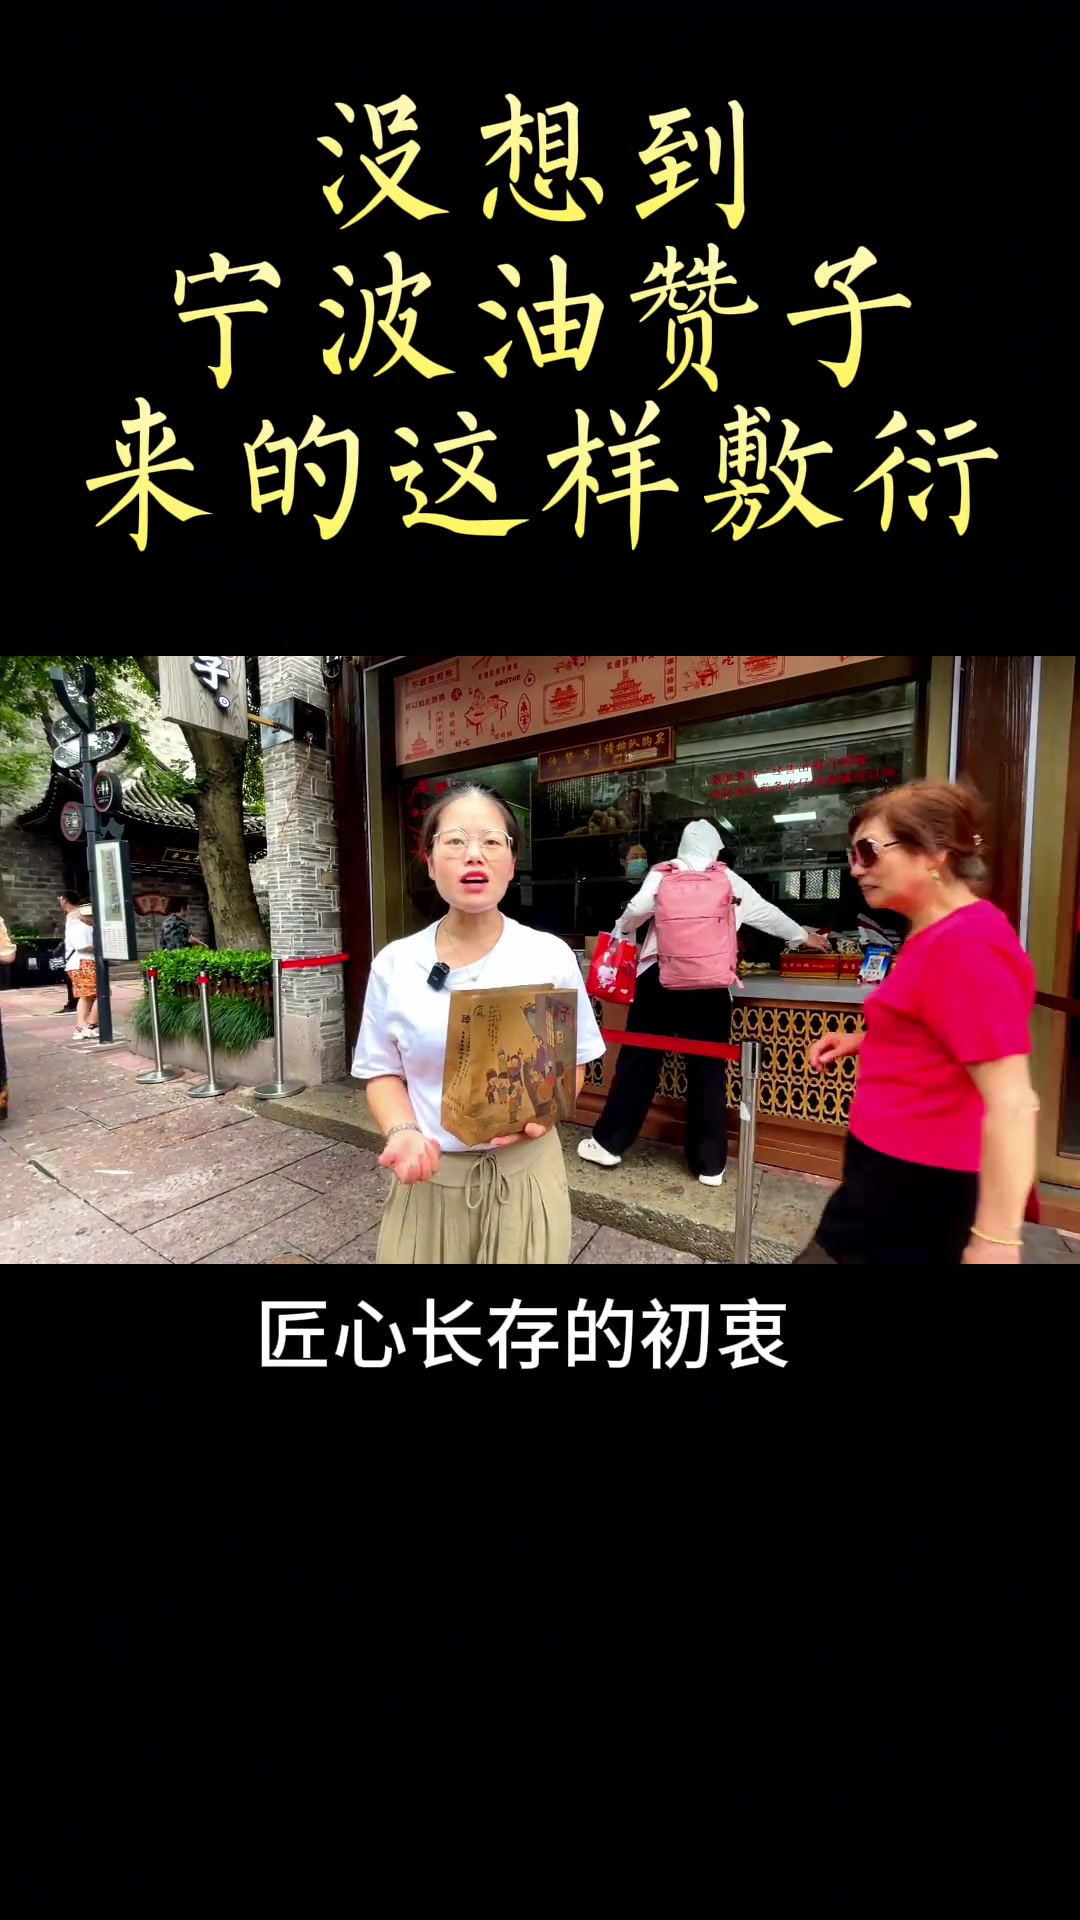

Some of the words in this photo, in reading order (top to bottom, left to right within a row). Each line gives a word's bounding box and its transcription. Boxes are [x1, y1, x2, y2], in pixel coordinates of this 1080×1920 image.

[454, 738, 471, 748] 好吃
[604, 732, 666, 756] 请排队购买
